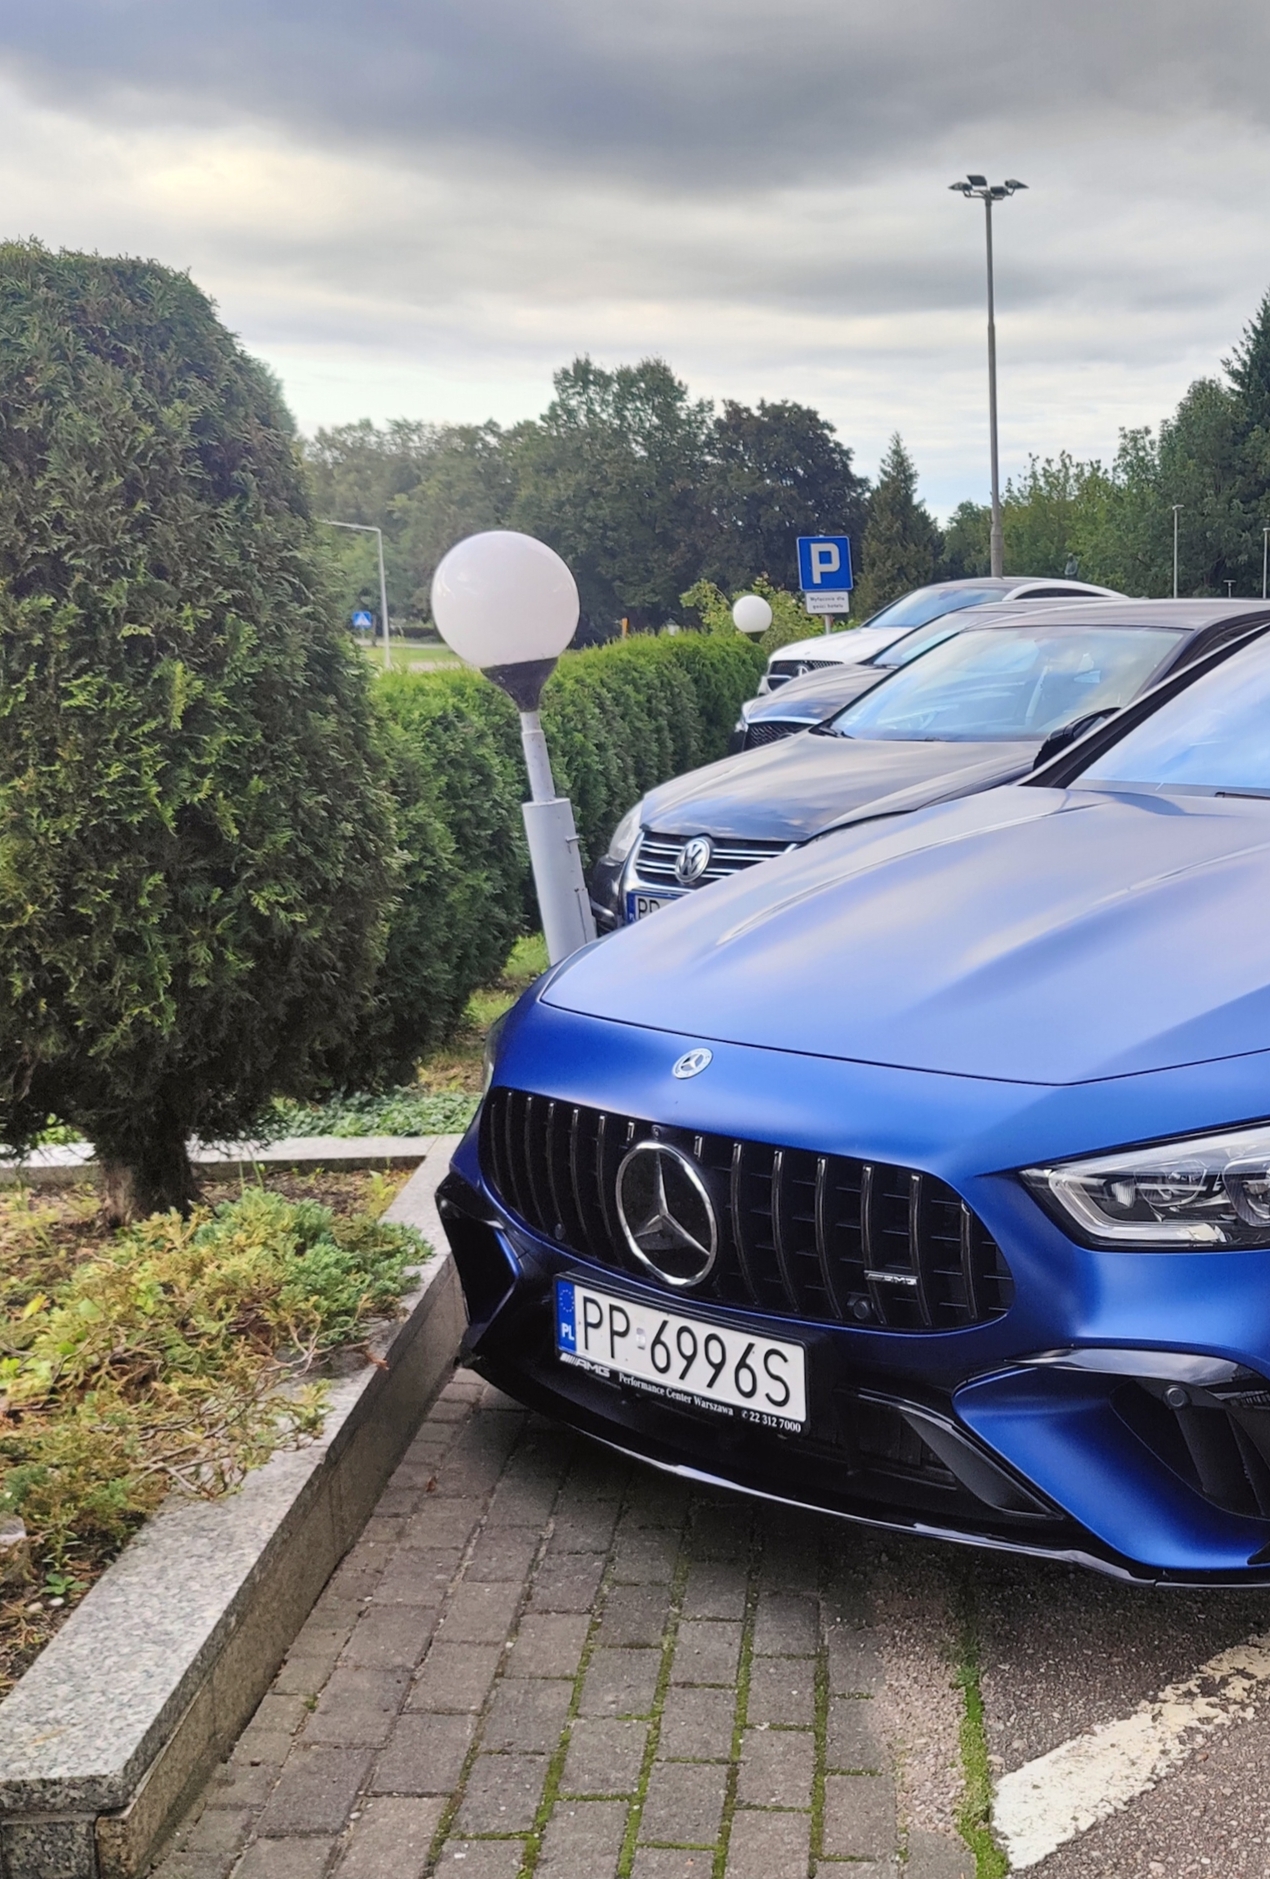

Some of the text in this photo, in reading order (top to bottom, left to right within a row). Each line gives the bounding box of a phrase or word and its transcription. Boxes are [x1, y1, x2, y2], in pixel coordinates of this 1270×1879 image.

[810, 542, 840, 584] P
[561, 1322, 575, 1342] PL
[583, 1295, 791, 1408] PP 6996S
[619, 1372, 665, 1397] Performance
[666, 1387, 693, 1404] Center
[694, 1395, 734, 1417] Warszawa
[749, 1411, 761, 1423] 22
[762, 1414, 778, 1428] 312
[780, 1418, 802, 1433] 7000
